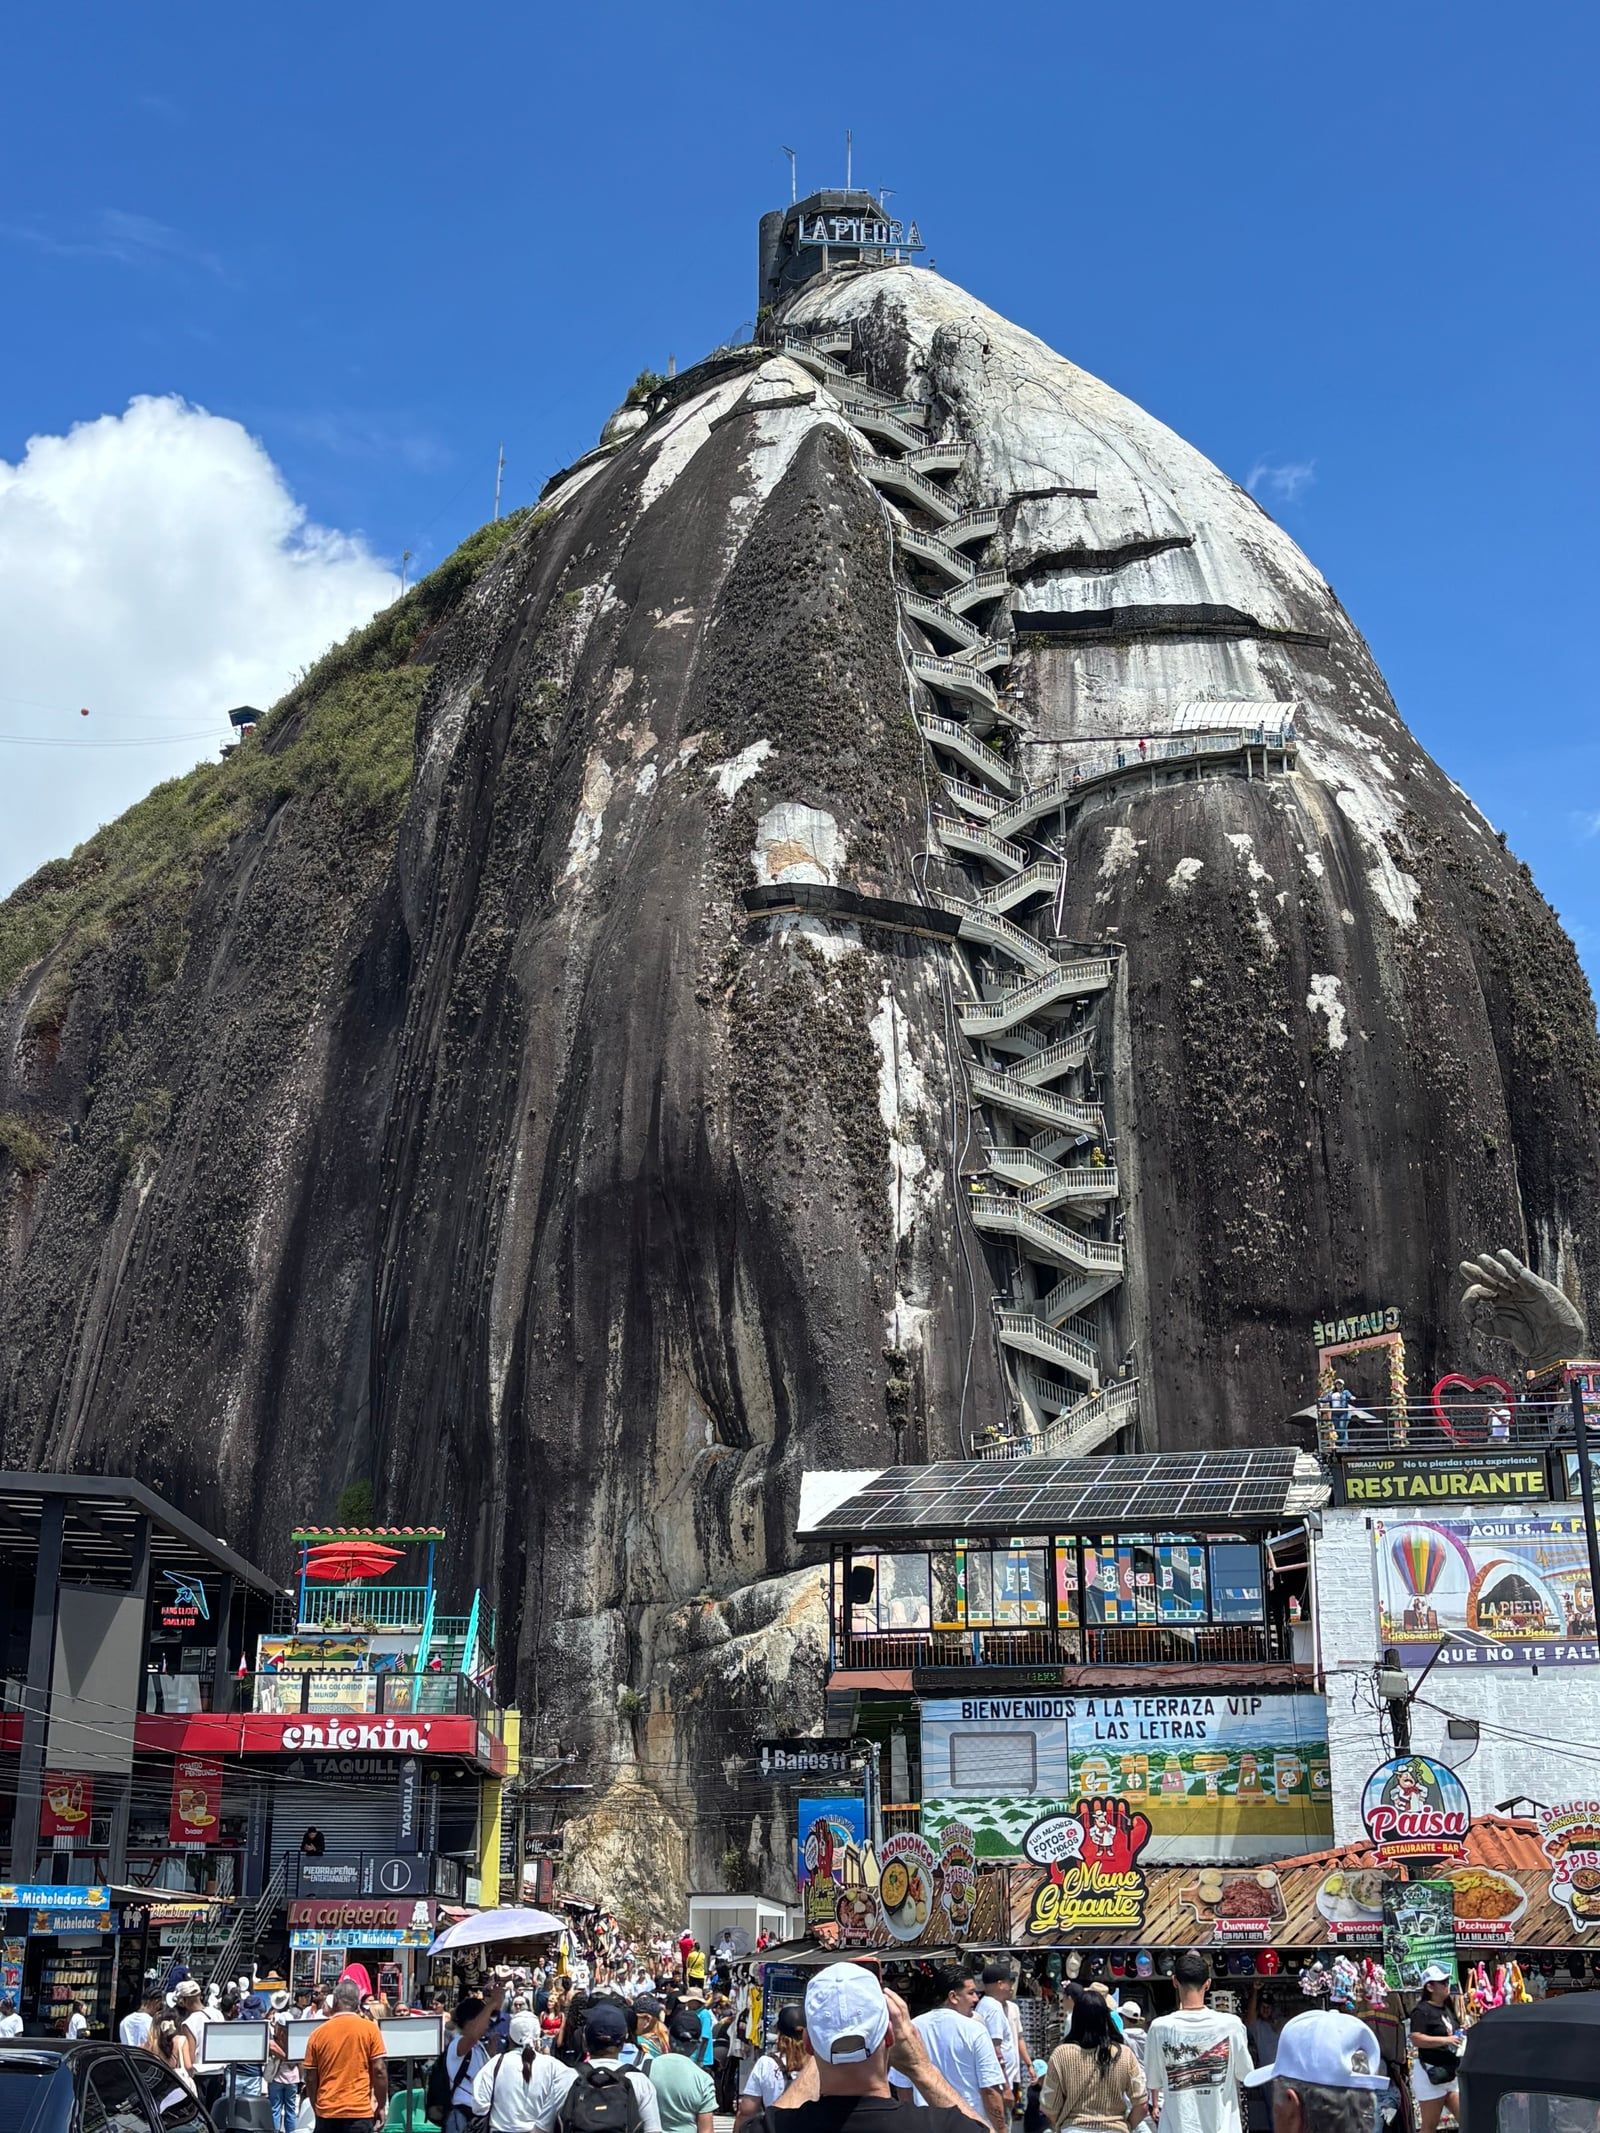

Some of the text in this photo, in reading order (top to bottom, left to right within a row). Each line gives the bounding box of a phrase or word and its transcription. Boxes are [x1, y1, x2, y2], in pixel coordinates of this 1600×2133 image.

[799, 215, 922, 245] LA PIEDRA
[1377, 1461, 1395, 1470] VIP
[1403, 1460, 1416, 1468] No
[1429, 1459, 1463, 1469] pierdas
[1485, 1457, 1537, 1466] experiencia
[1346, 1471, 1545, 1498] RESTAURANTE
[1471, 1524, 1510, 1537] AQUI
[1551, 1519, 1563, 1533] 4
[1481, 1600, 1552, 1617] LA PIEDRA
[1437, 1648, 1477, 1663] QUE
[1487, 1647, 1514, 1661] NO
[1523, 1647, 1546, 1660] TE
[961, 1700, 1076, 1719] BIENVENIDOS
[1086, 1700, 1097, 1717] A
[1104, 1699, 1125, 1717] LA
[1133, 1698, 1215, 1717] TERRAZA
[282, 1718, 432, 1750] chickin'
[1095, 1720, 1207, 1739] LAS LETRAS
[314, 1758, 399, 1774] TAQUILL
[774, 1749, 829, 1770] Baños
[401, 1776, 414, 1838] TAQUILLA
[1029, 1820, 1073, 1846] TUS MEJORES
[1366, 1805, 1468, 1842] Paisa
[881, 1836, 933, 1865] MONDONGO
[1033, 1832, 1066, 1856] FOTOS
[1041, 1836, 1079, 1861] Y VIDEOS
[1068, 1847, 1075, 1855] LA
[1381, 1843, 1436, 1856] RESTAURANTE
[1442, 1843, 1460, 1853] BAR
[1063, 1861, 1142, 1898] Mano
[1555, 1859, 1570, 1883] 3
[22, 1892, 83, 1906] Micheladas
[1030, 1883, 1145, 1934] Gigante
[53, 1916, 96, 1930] Micheladas
[288, 1902, 399, 1927] La cafetería
[1222, 1922, 1265, 1932] Churrasco
[1456, 1932, 1461, 1941] A
[1462, 1932, 1470, 1941] LA
[1471, 1932, 1505, 1941] MILANESA
[1458, 1921, 1506, 1932] Pechuga
[1346, 1933, 1377, 1942] DE BAGRE
